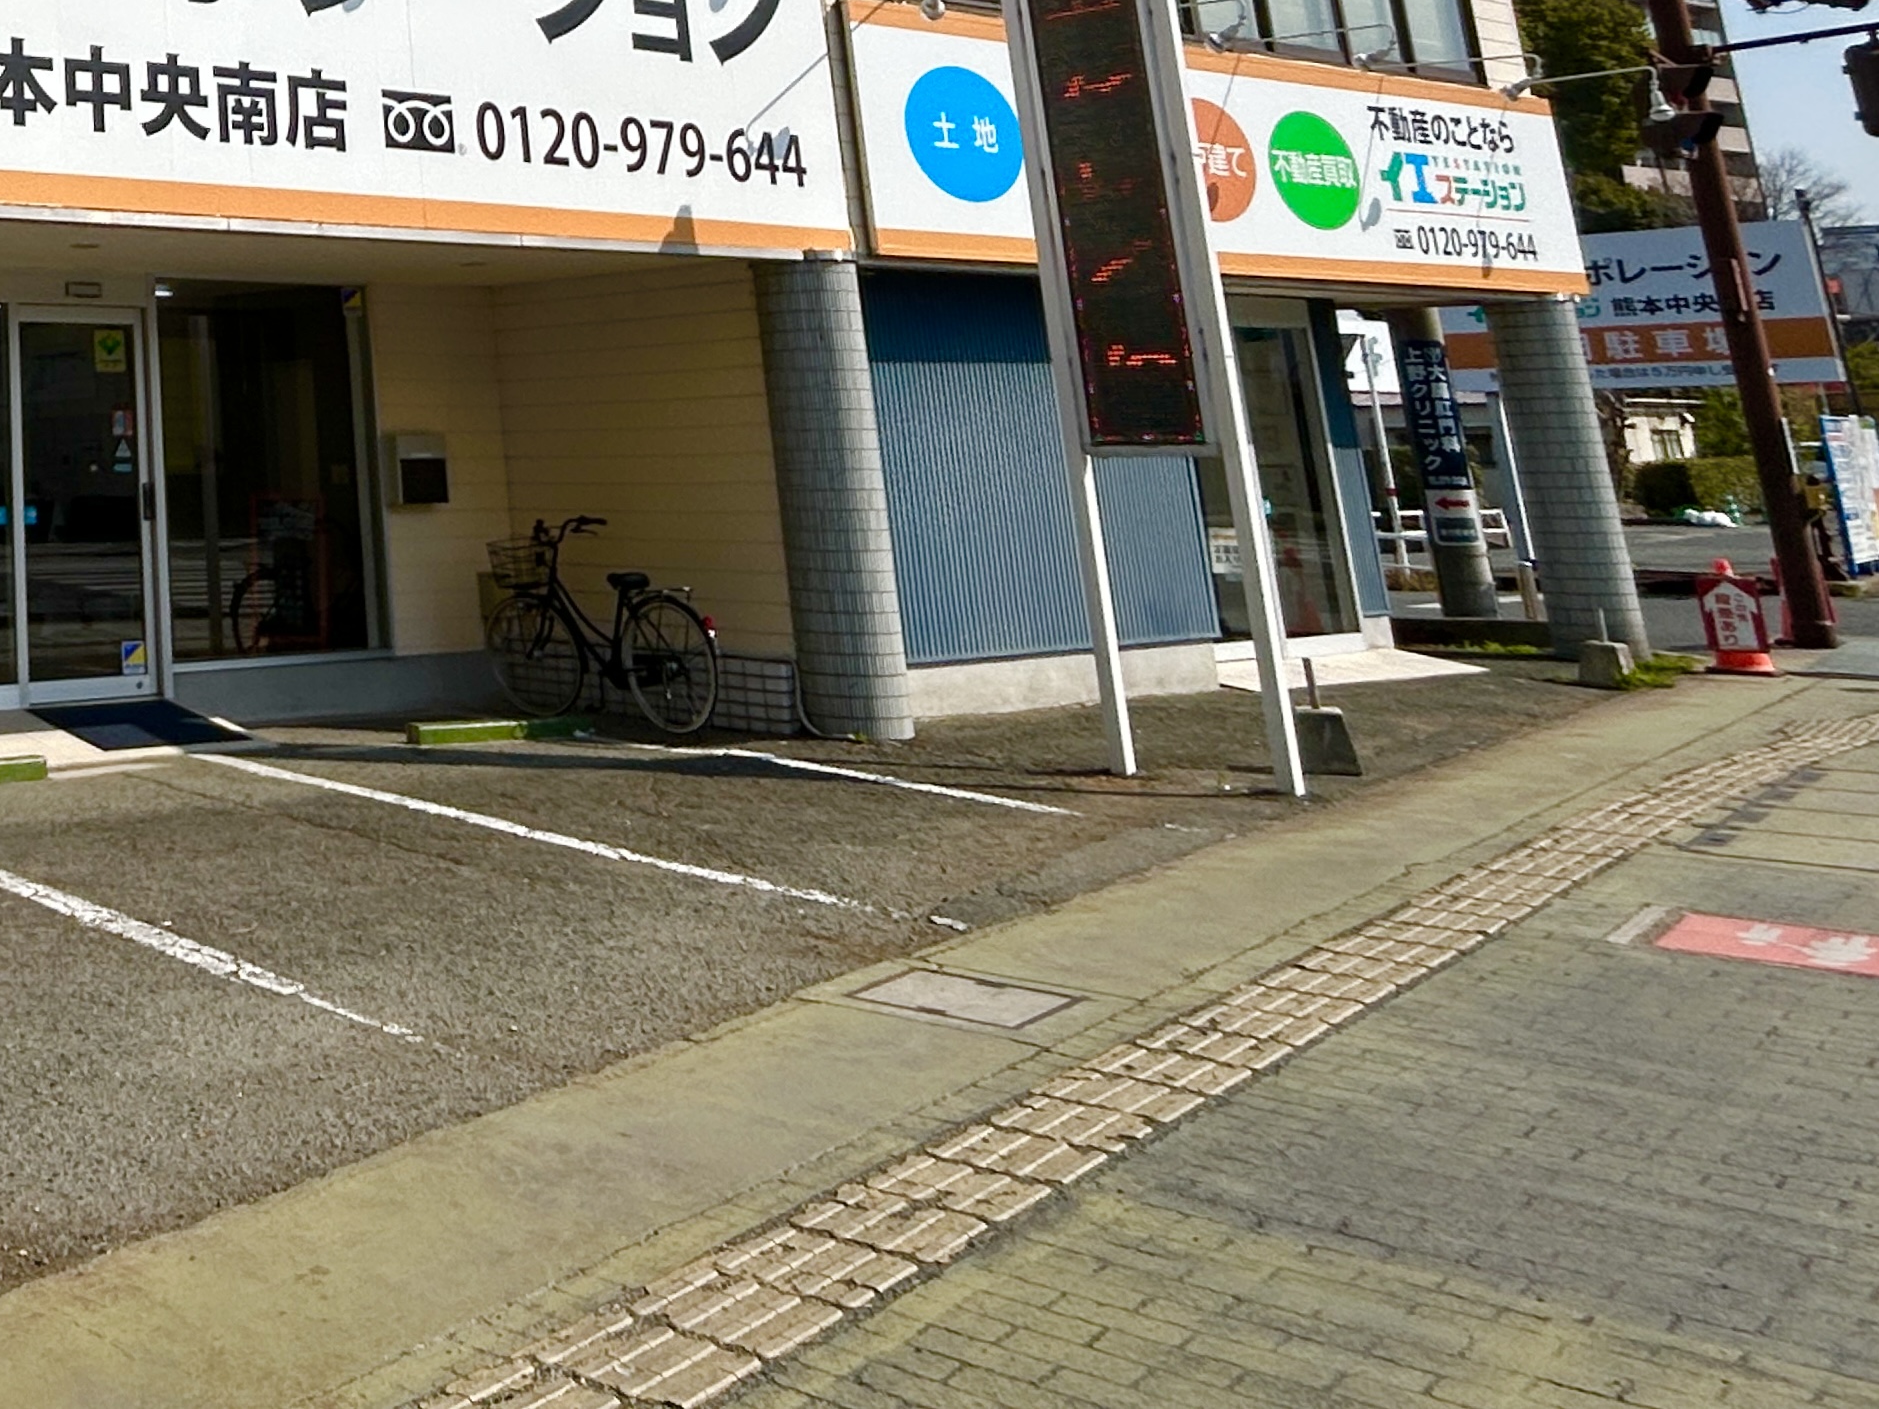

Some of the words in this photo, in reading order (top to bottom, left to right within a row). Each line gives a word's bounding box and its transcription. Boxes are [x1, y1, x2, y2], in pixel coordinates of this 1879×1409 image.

[476, 101, 808, 188] 0120-979-644
[932, 111, 1000, 154] 土地
[1367, 105, 1515, 153] 不動産のことなら
[1270, 148, 1358, 188] 不動産買取
[1417, 225, 1538, 261] 0120-979-644
[1610, 288, 1776, 318] 熊本中央店
[1404, 347, 1442, 471] 上野クリニック
